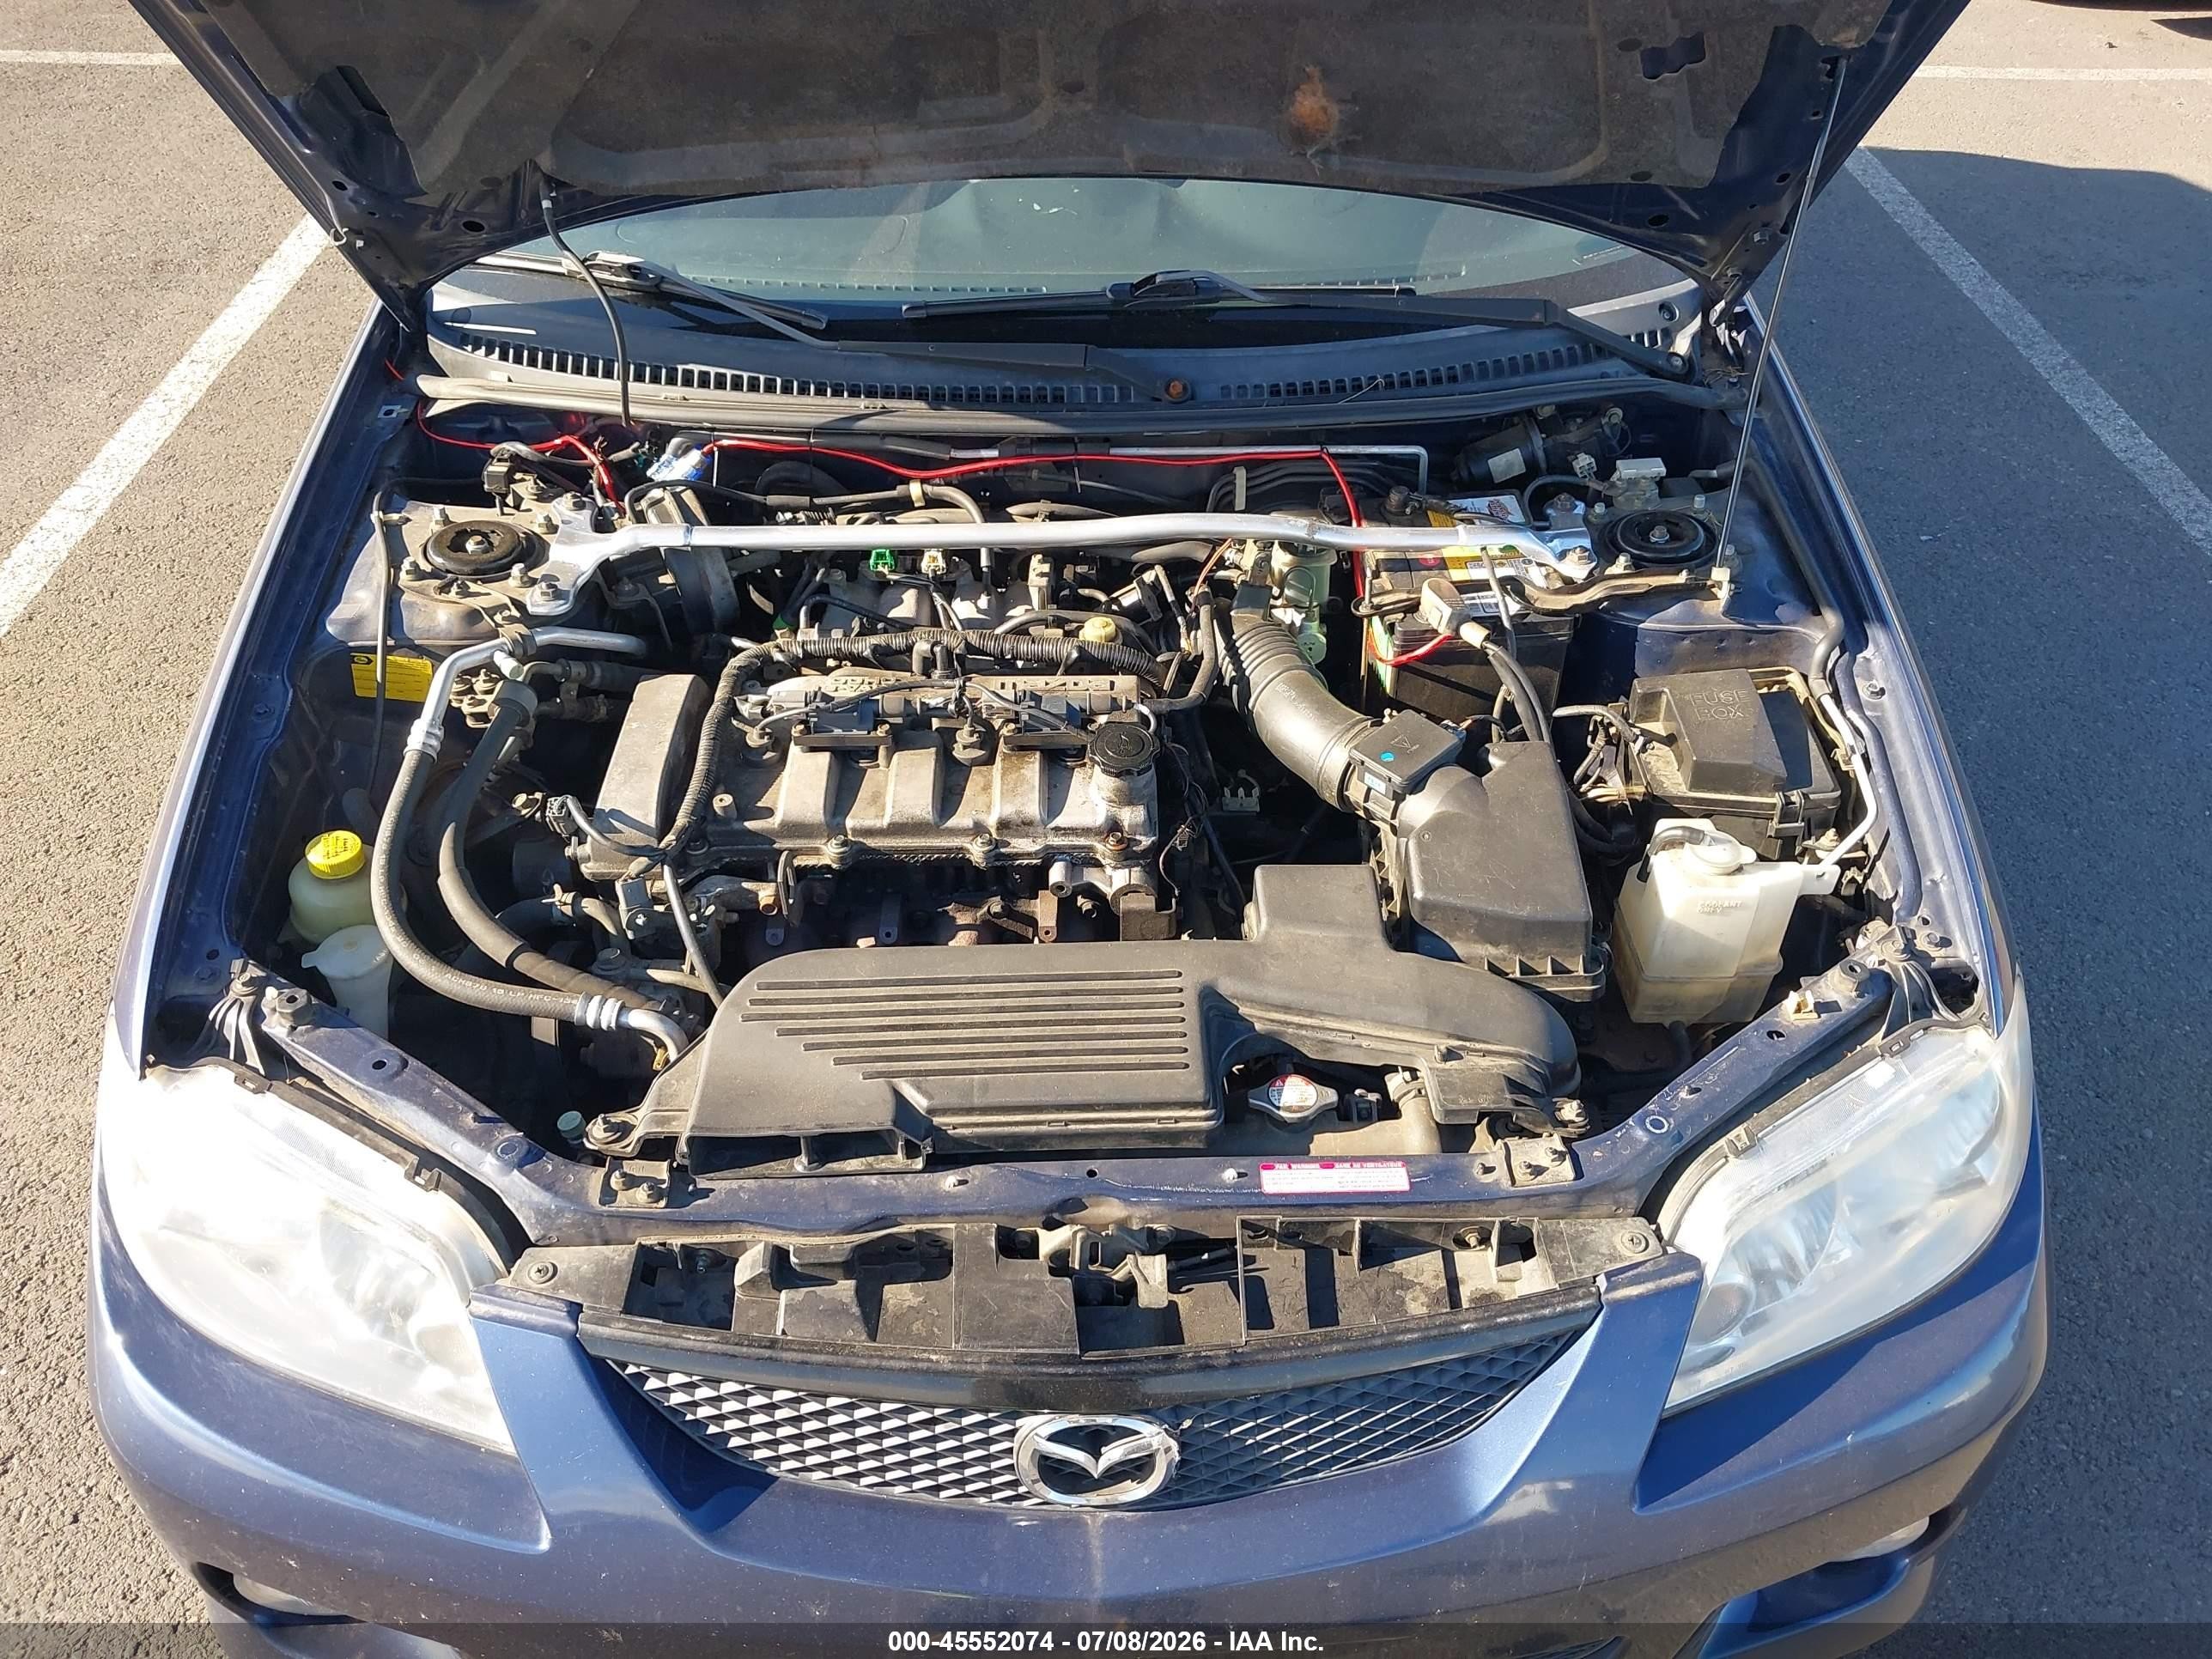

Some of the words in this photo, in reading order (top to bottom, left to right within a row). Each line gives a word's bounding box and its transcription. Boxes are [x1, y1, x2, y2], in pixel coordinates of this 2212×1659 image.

[1689, 689, 1751, 706] FUSE
[1694, 704, 1744, 720] BOX
[1697, 899, 1743, 908] COOLANT
